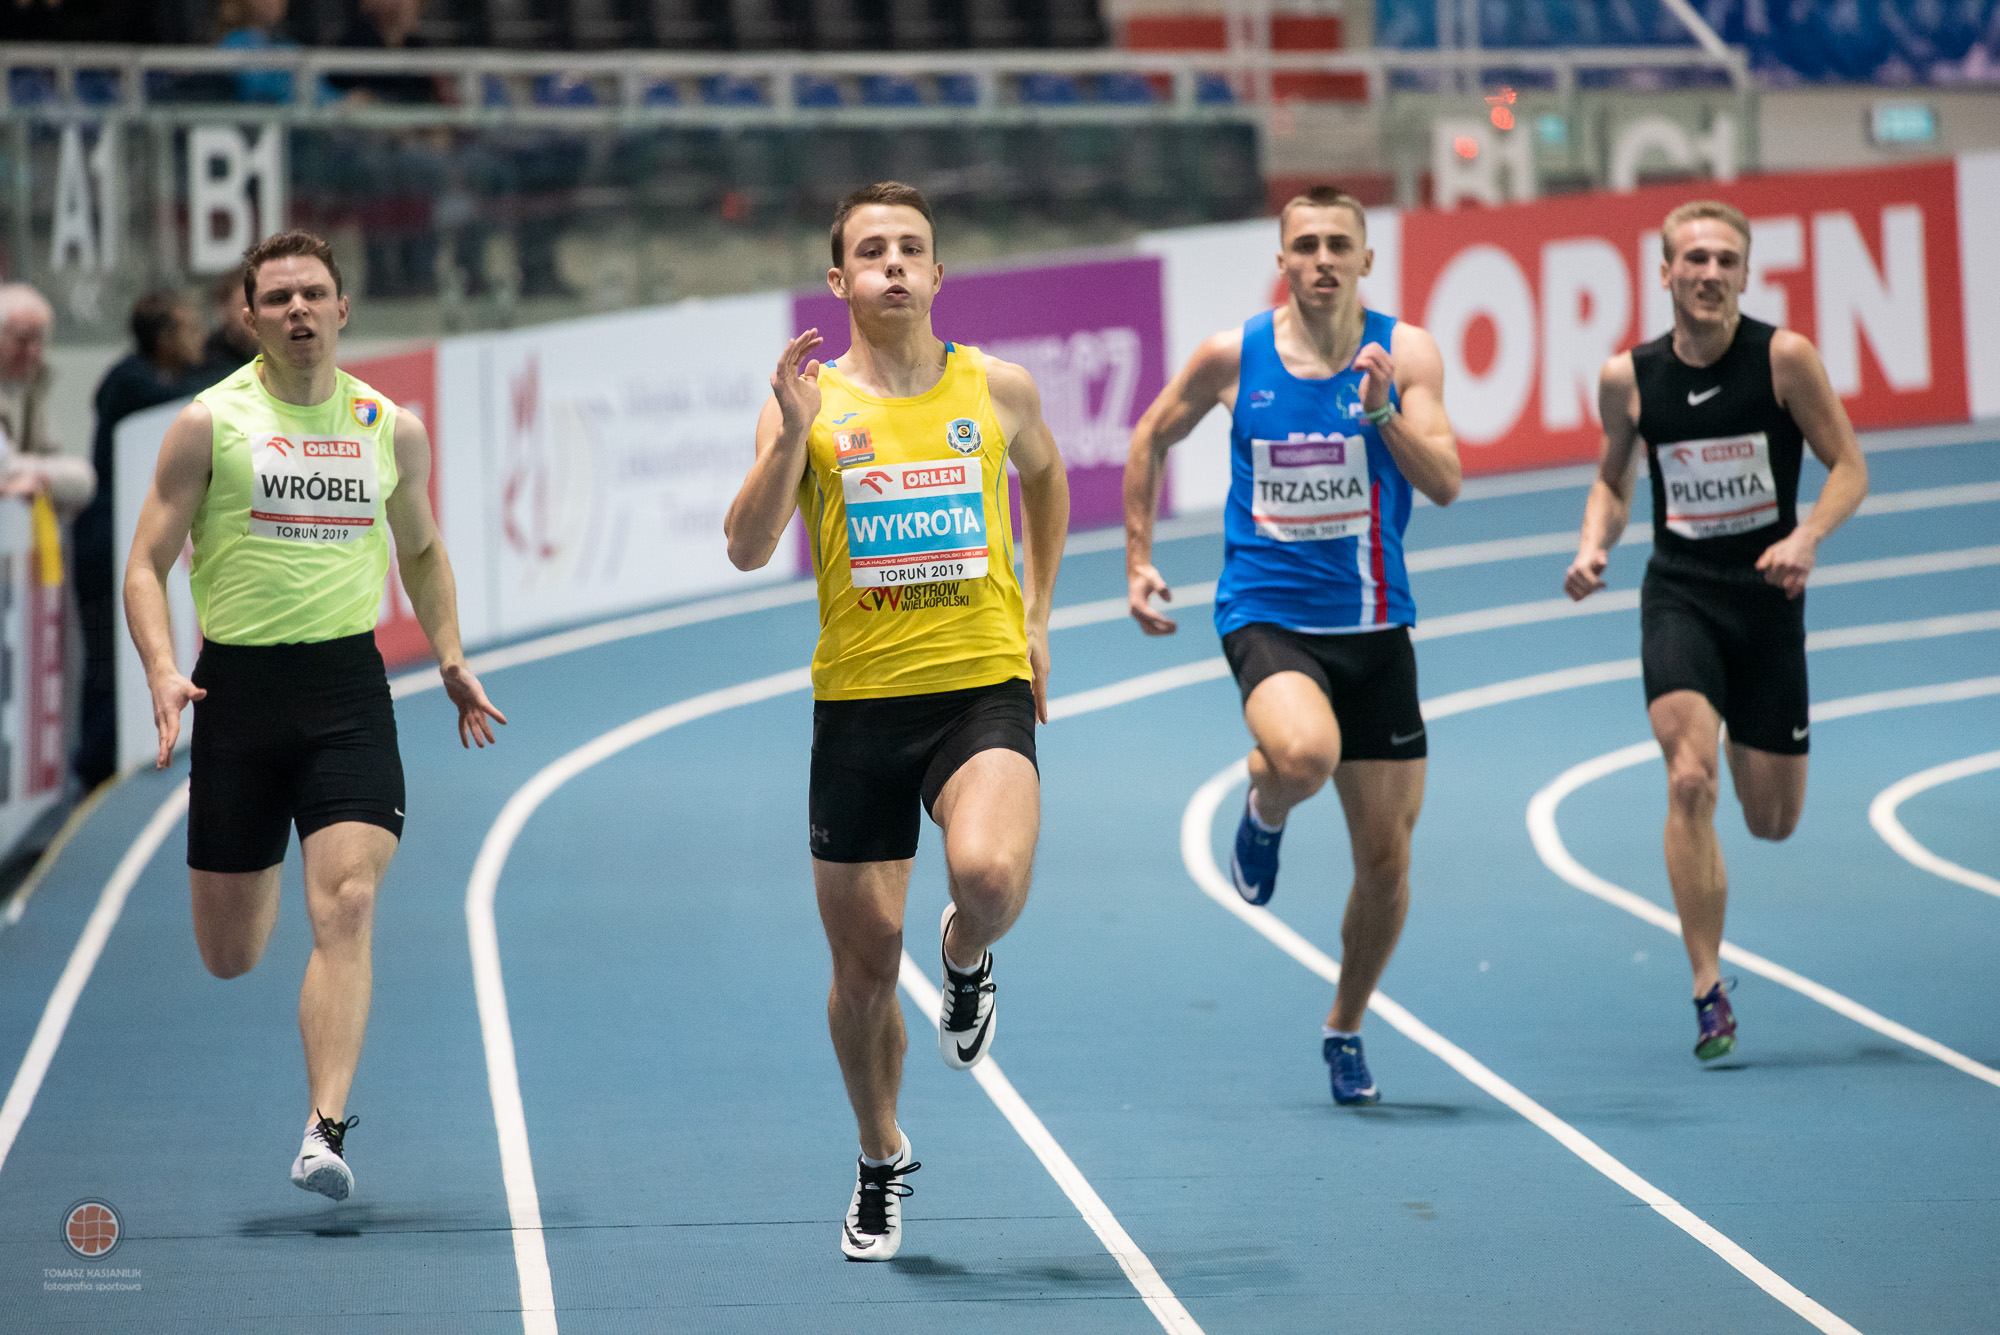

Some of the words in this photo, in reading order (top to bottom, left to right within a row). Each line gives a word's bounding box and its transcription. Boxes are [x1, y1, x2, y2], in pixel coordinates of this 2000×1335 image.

[51, 122, 117, 273] A1
[189, 121, 283, 275] B1
[306, 442, 359, 457] ORLEN
[838, 433, 868, 452] BM
[905, 468, 962, 487] ORLEN
[261, 472, 371, 503] WRÓBEL
[1258, 477, 1363, 503] TRZASKA
[1671, 473, 1765, 503] PLICHTA
[276, 525, 318, 539] TORUŃ
[322, 529, 349, 540] 2019
[851, 507, 980, 543] WYKROTA
[897, 555, 940, 564] MISTRZOSTWA
[879, 563, 926, 582] TORUŃ
[931, 563, 964, 578] 2019
[904, 581, 960, 600] OSTRÓW
[901, 595, 969, 612] WIELKOPOLSKI
